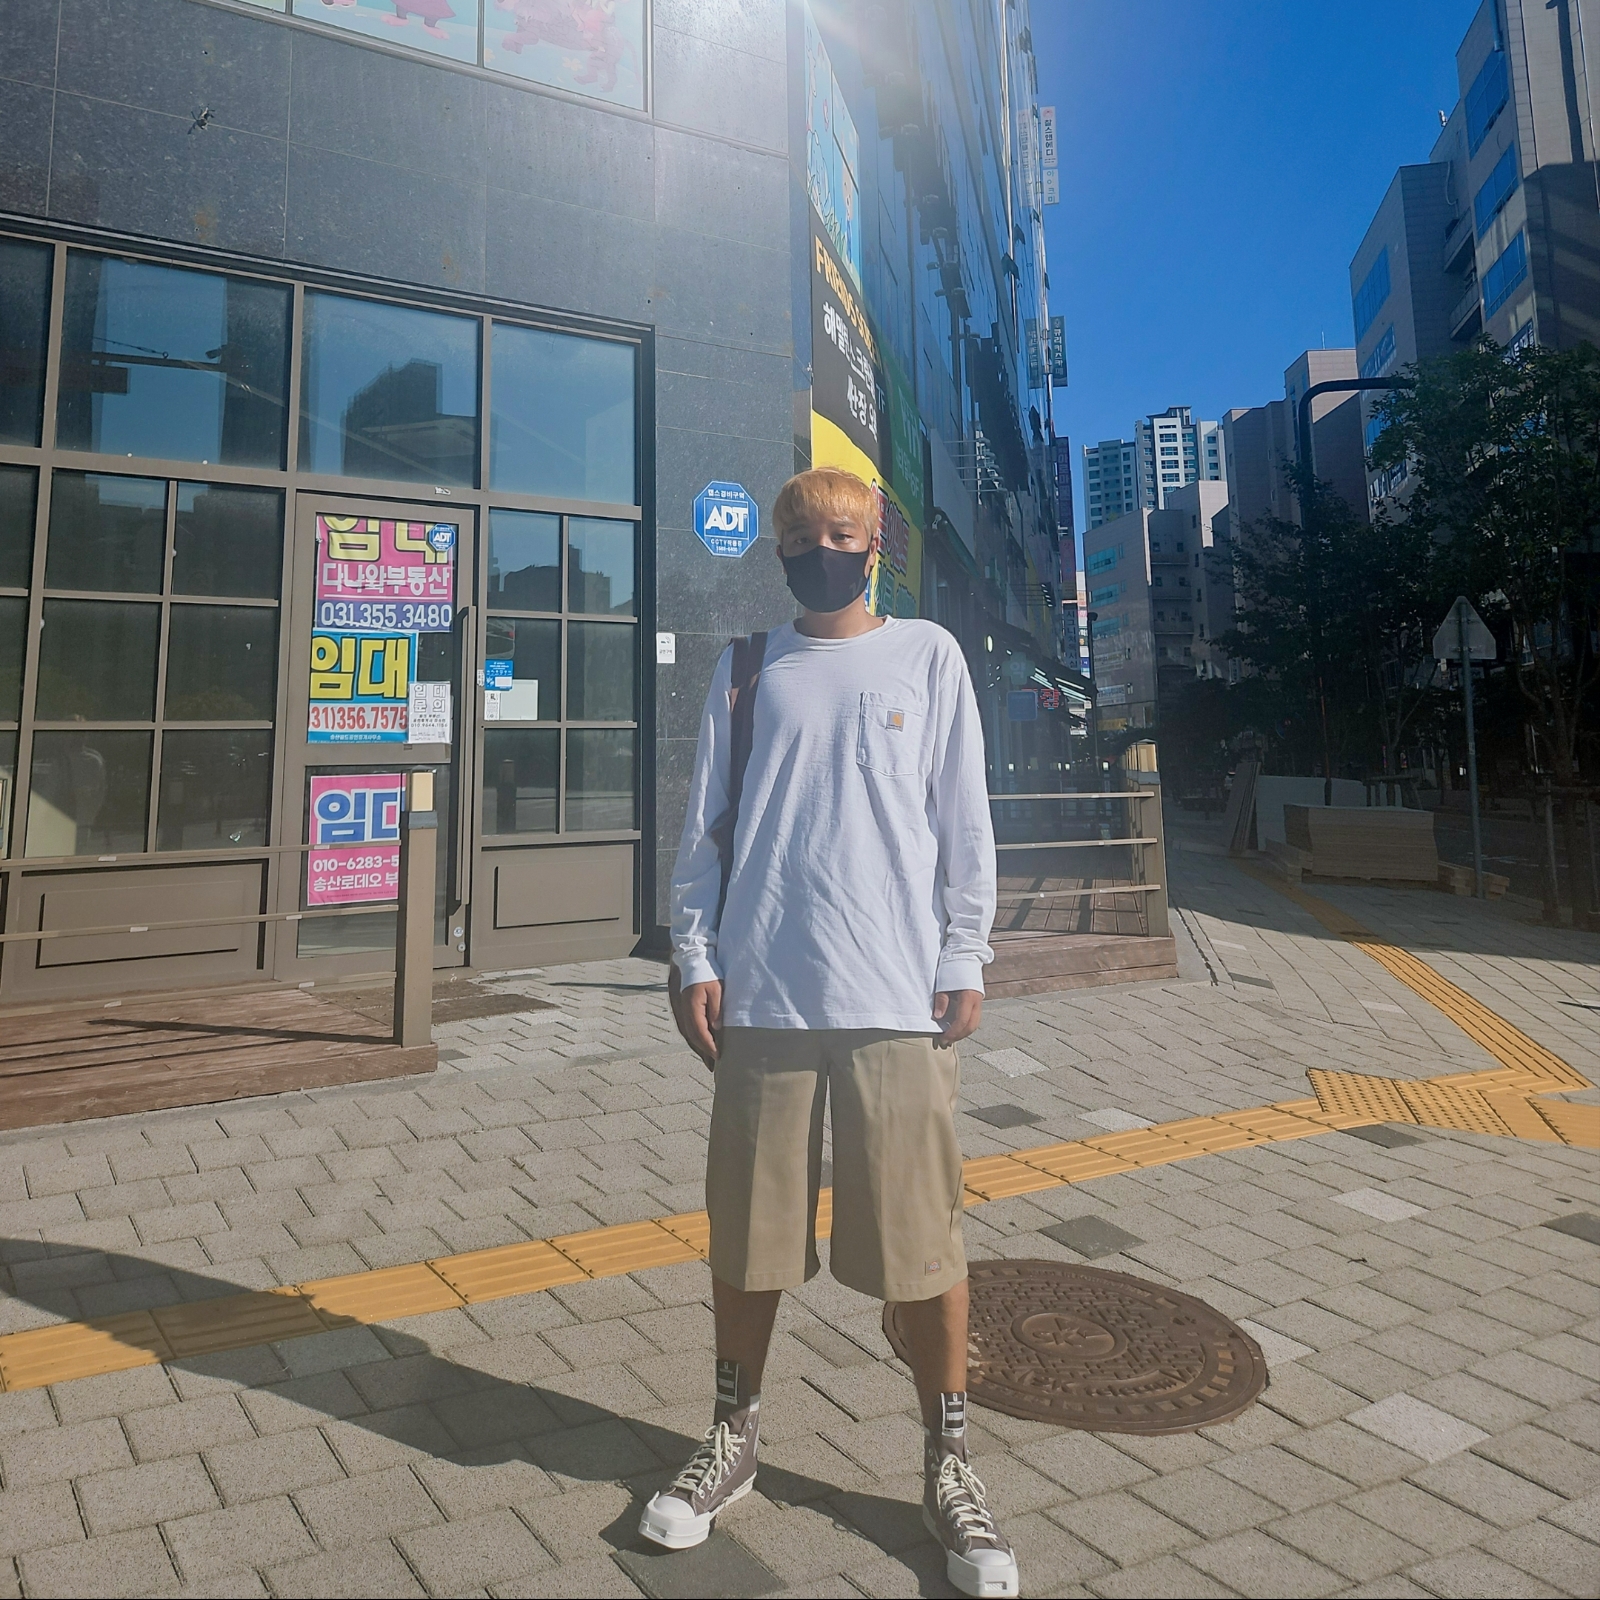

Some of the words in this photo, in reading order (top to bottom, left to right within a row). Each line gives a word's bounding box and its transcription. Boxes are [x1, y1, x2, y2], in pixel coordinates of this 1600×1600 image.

[705, 505, 749, 533] ADT
[433, 532, 452, 543] ADT
[322, 563, 450, 596] 다나와부동산
[320, 602, 452, 628] 031.355.3480
[310, 636, 409, 699] 임대
[309, 706, 408, 730] 31)356.7575
[313, 873, 383, 892] 송산로데오
